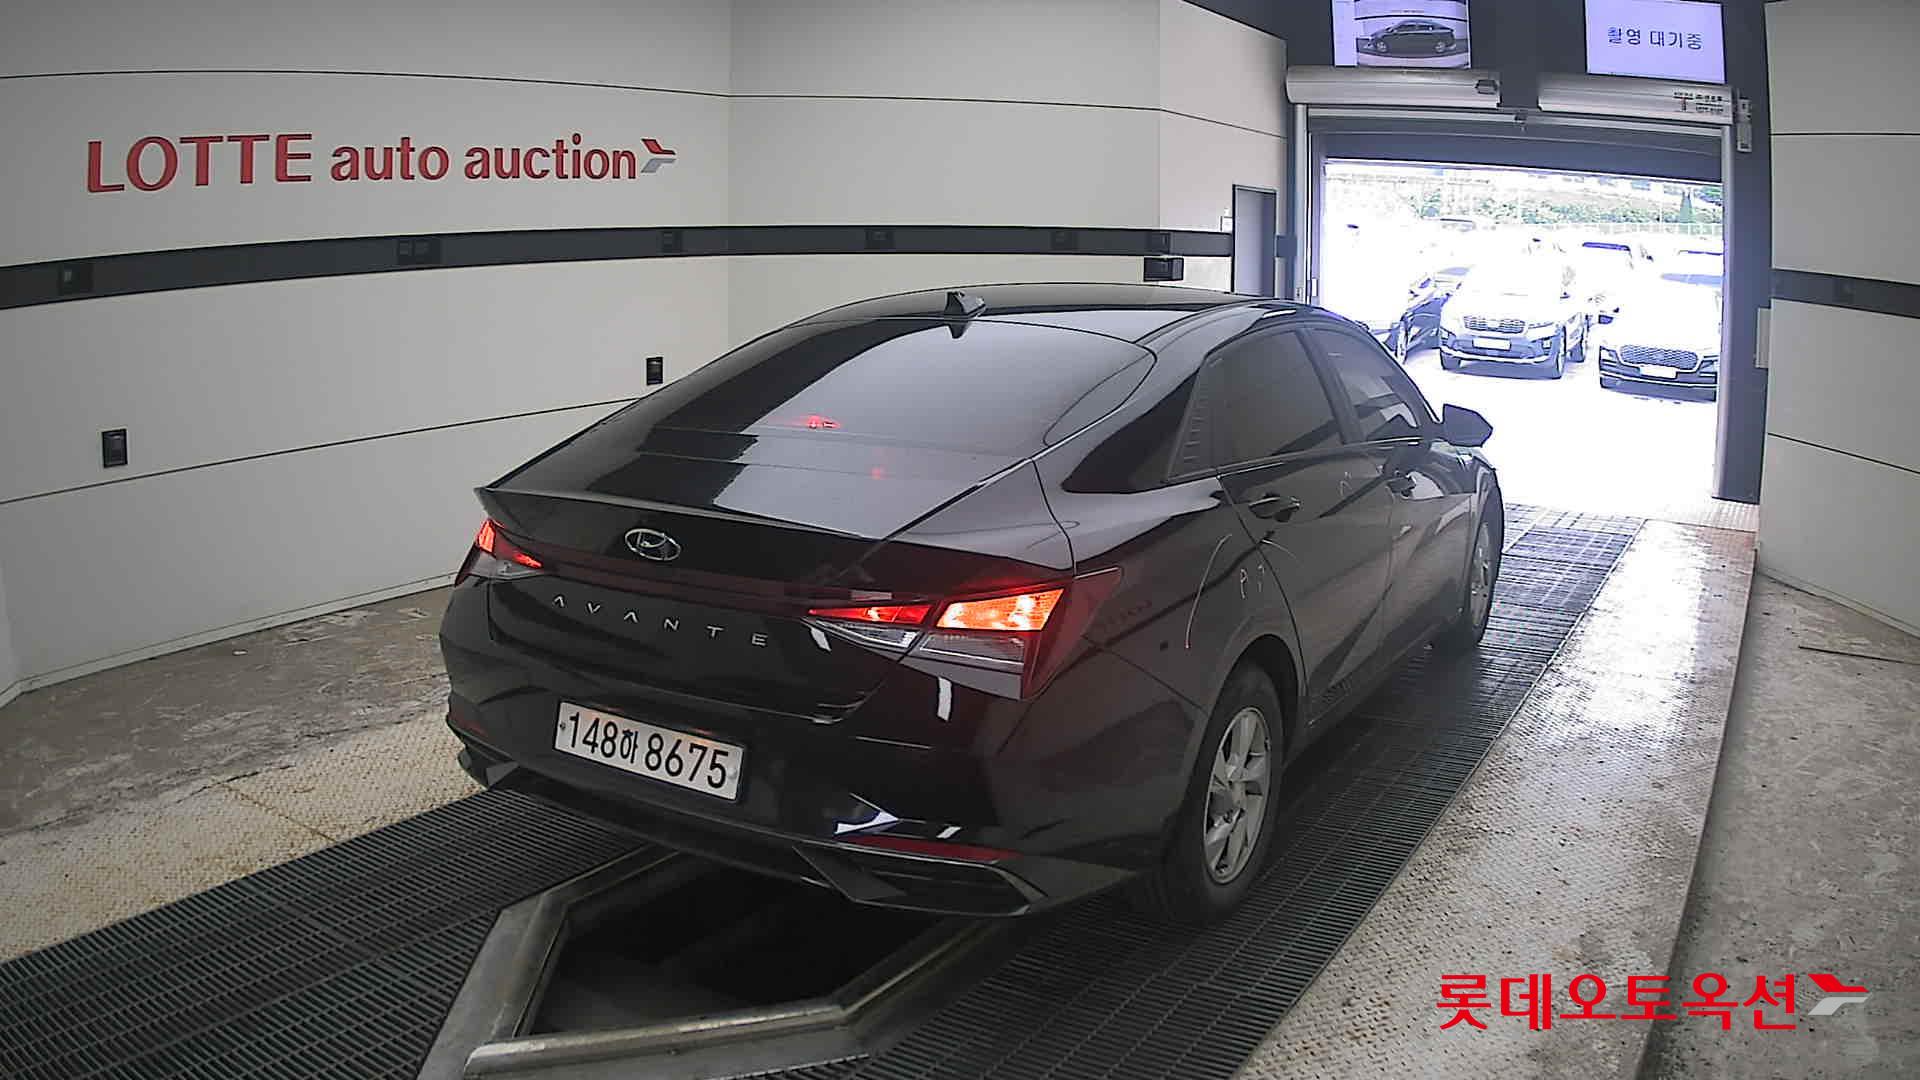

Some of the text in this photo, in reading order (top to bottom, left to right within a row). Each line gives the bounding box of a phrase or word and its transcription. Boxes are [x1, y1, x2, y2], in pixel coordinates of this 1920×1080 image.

[1649, 31, 1702, 50] 대기중
[88, 133, 637, 193] LOTTE auto auction
[553, 595, 768, 647] AVANTE
